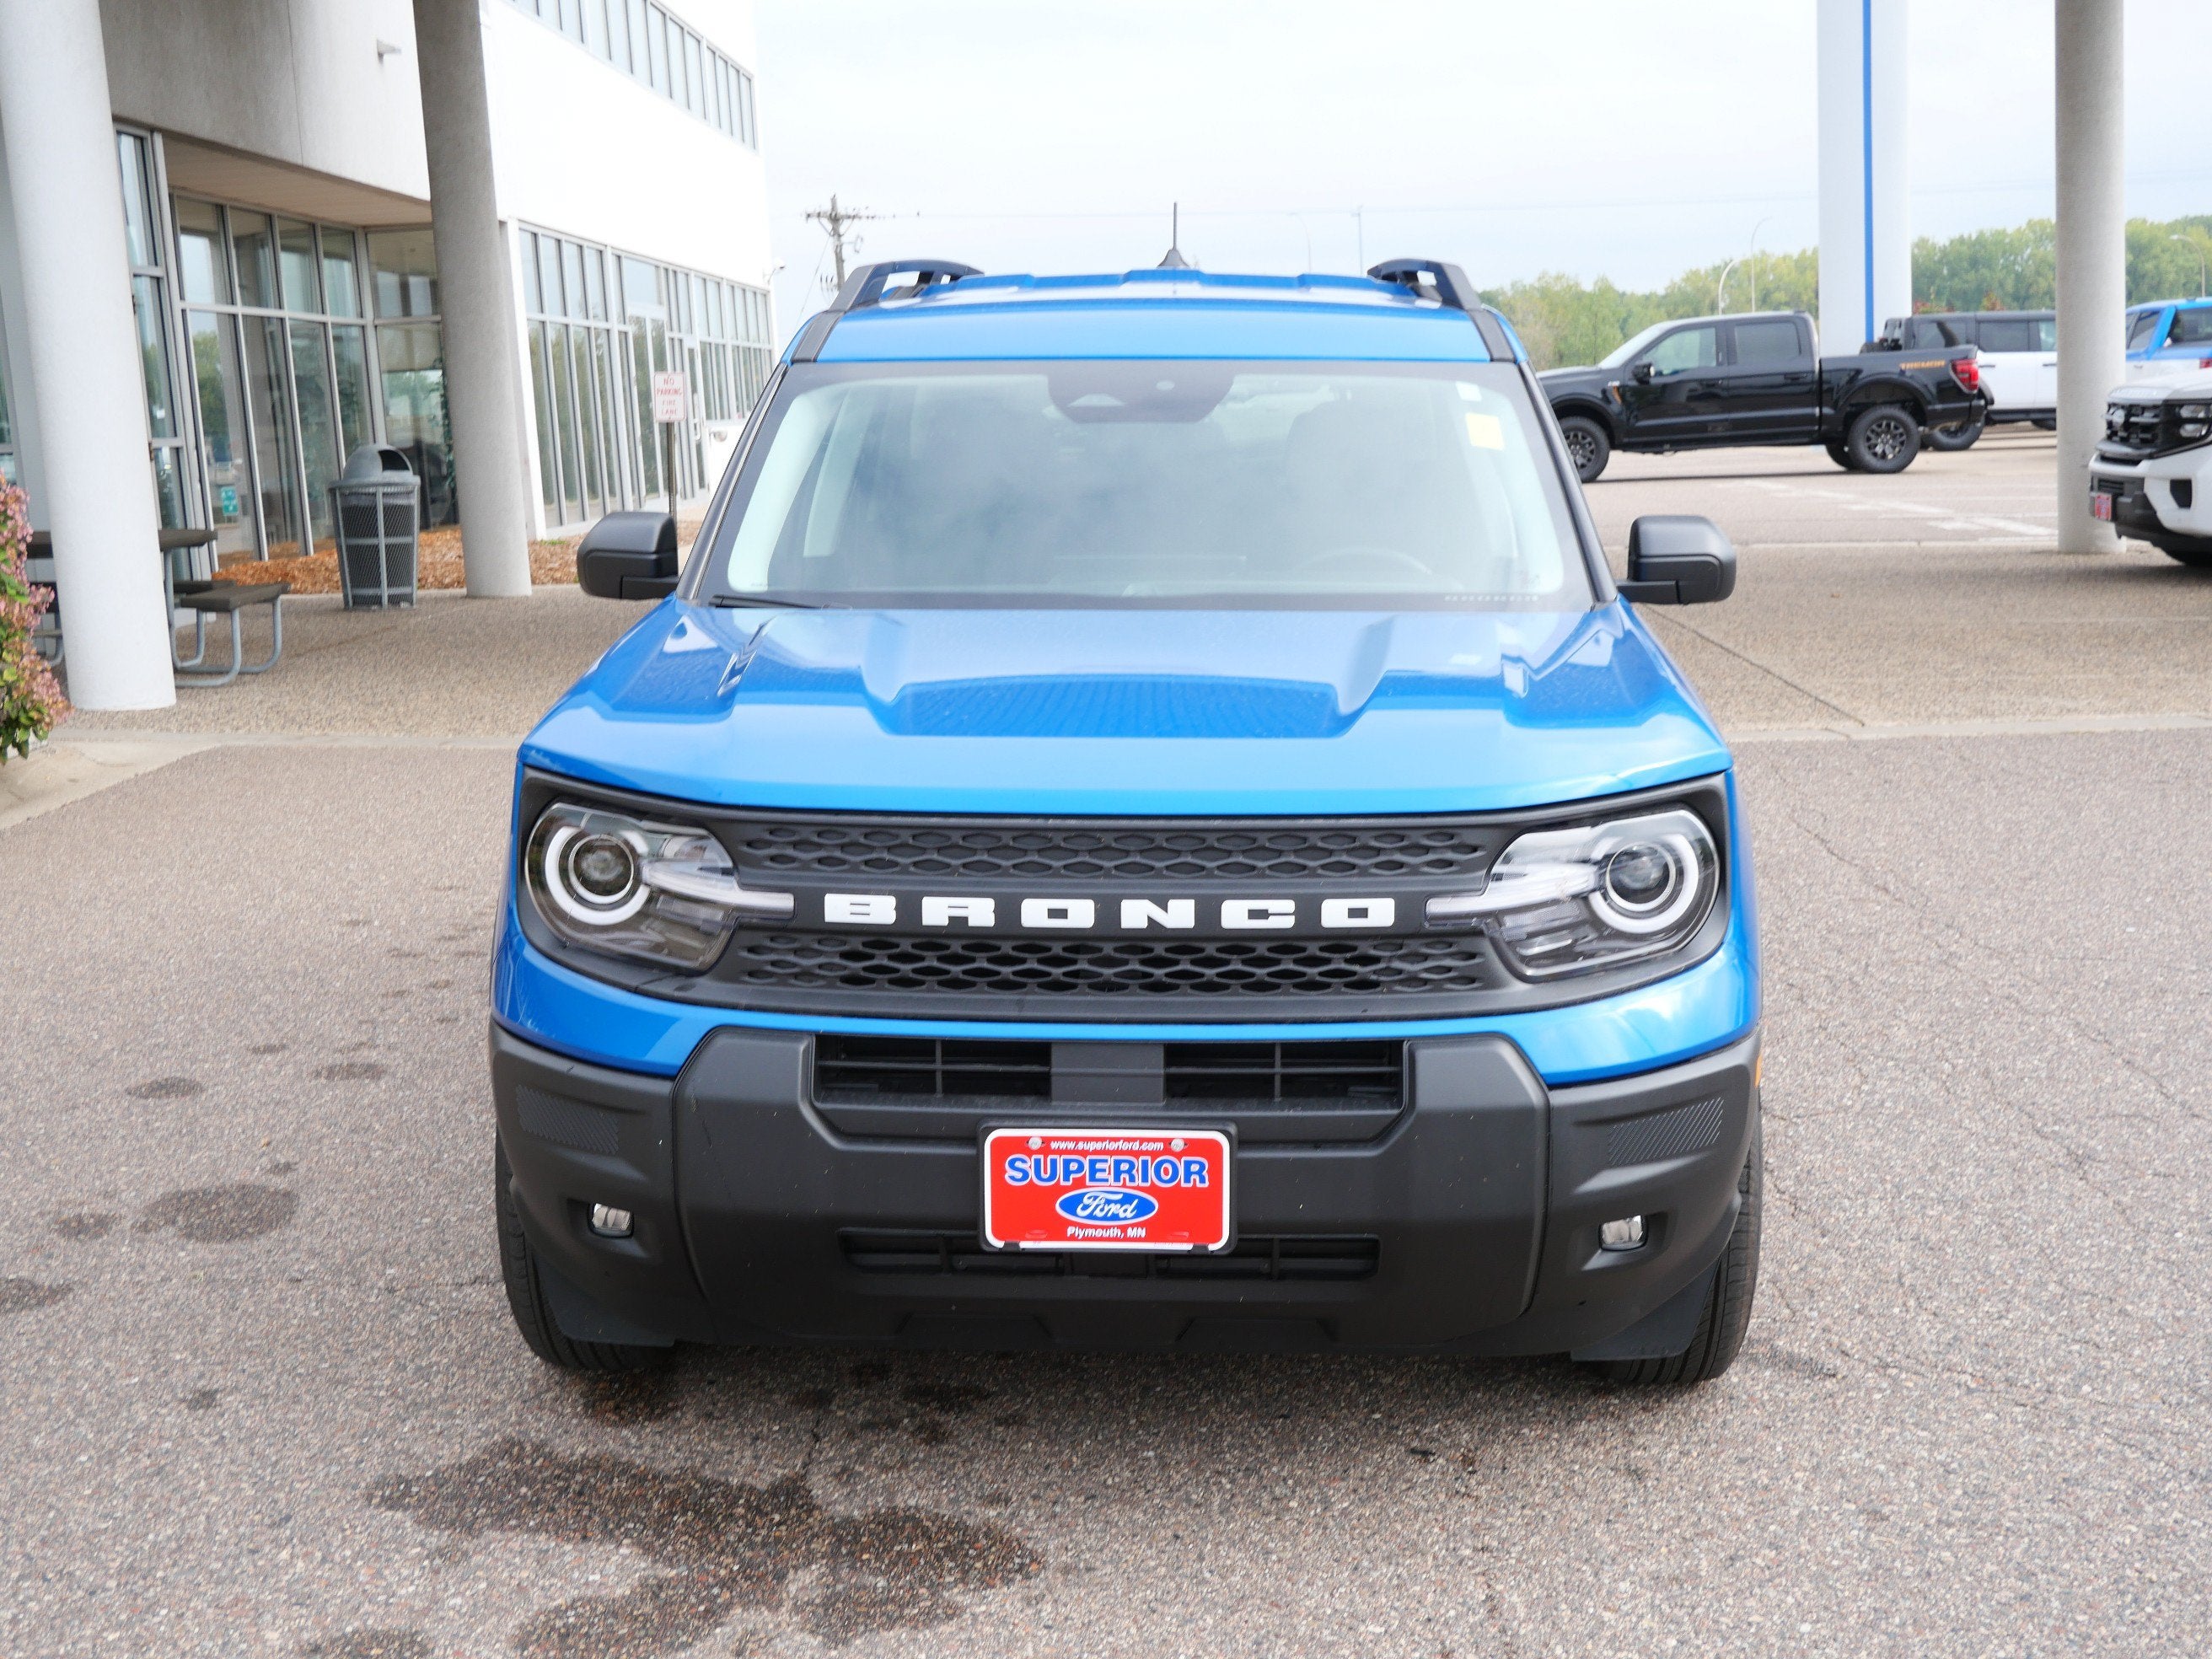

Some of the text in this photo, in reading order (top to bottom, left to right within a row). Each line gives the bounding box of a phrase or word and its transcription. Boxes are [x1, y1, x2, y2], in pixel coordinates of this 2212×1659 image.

[663, 377, 674, 385] NO
[824, 893, 1395, 929] BRONCO
[1050, 1139, 1163, 1152] www.superiorford.com
[1005, 1154, 1210, 1188] SUPERIOR
[1076, 1190, 1138, 1219] Ford
[1066, 1226, 1146, 1240] Plymouth, MN
